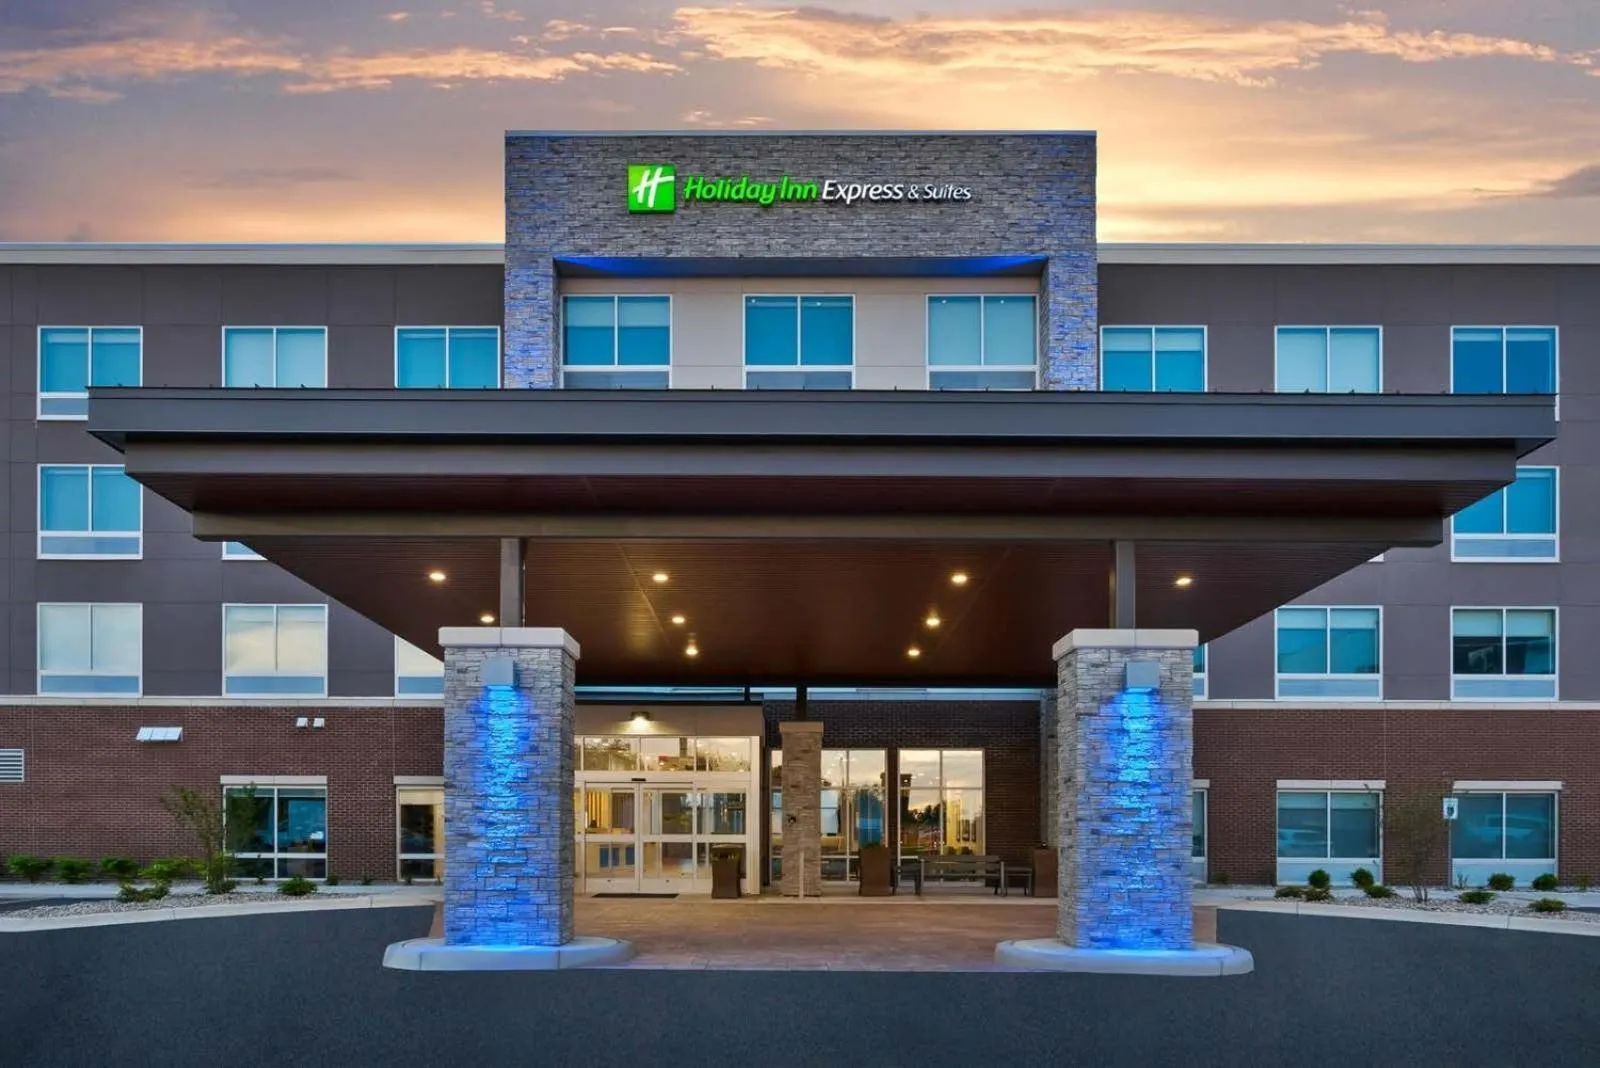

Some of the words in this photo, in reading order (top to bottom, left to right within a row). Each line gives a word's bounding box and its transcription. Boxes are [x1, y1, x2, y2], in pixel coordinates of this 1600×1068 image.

[684, 175, 776, 206] Holiday
[780, 175, 818, 201] Inn
[822, 179, 904, 205] Express
[908, 184, 919, 199] &
[923, 183, 972, 200] Suites
